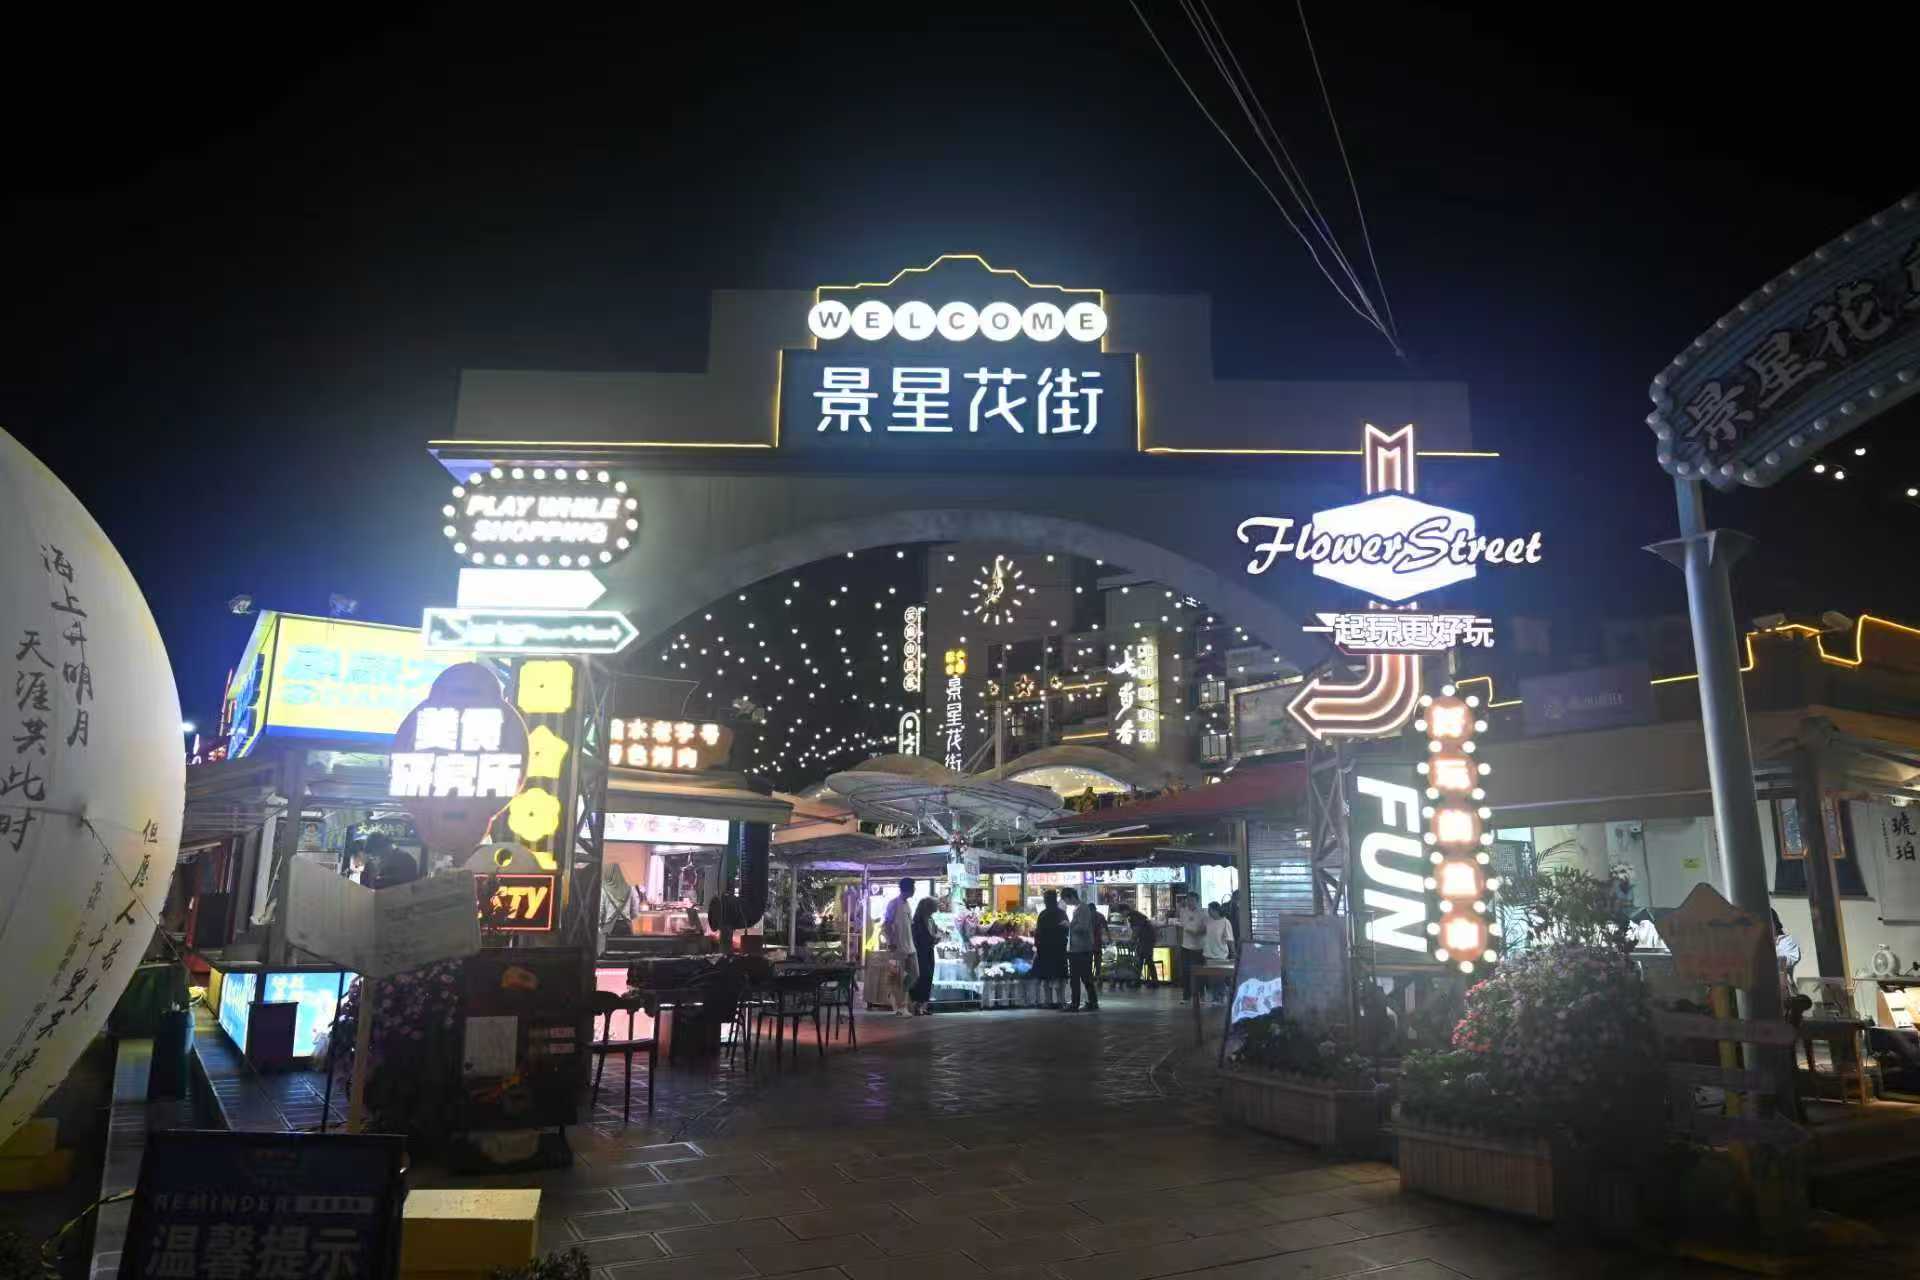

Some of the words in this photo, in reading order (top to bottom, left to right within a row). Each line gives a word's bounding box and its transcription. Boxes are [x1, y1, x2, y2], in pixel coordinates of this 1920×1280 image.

[816, 308, 1097, 333] WELCOME
[812, 366, 1103, 435] 景星花街
[465, 495, 536, 517] PLAY
[537, 496, 621, 519] WHILE
[470, 518, 609, 544] SHOPPING
[1302, 613, 1495, 649] 一起玩更好玩
[390, 752, 522, 797] 研究所
[1356, 775, 1428, 953] FUN
[146, 1224, 361, 1280] 温馨提示
